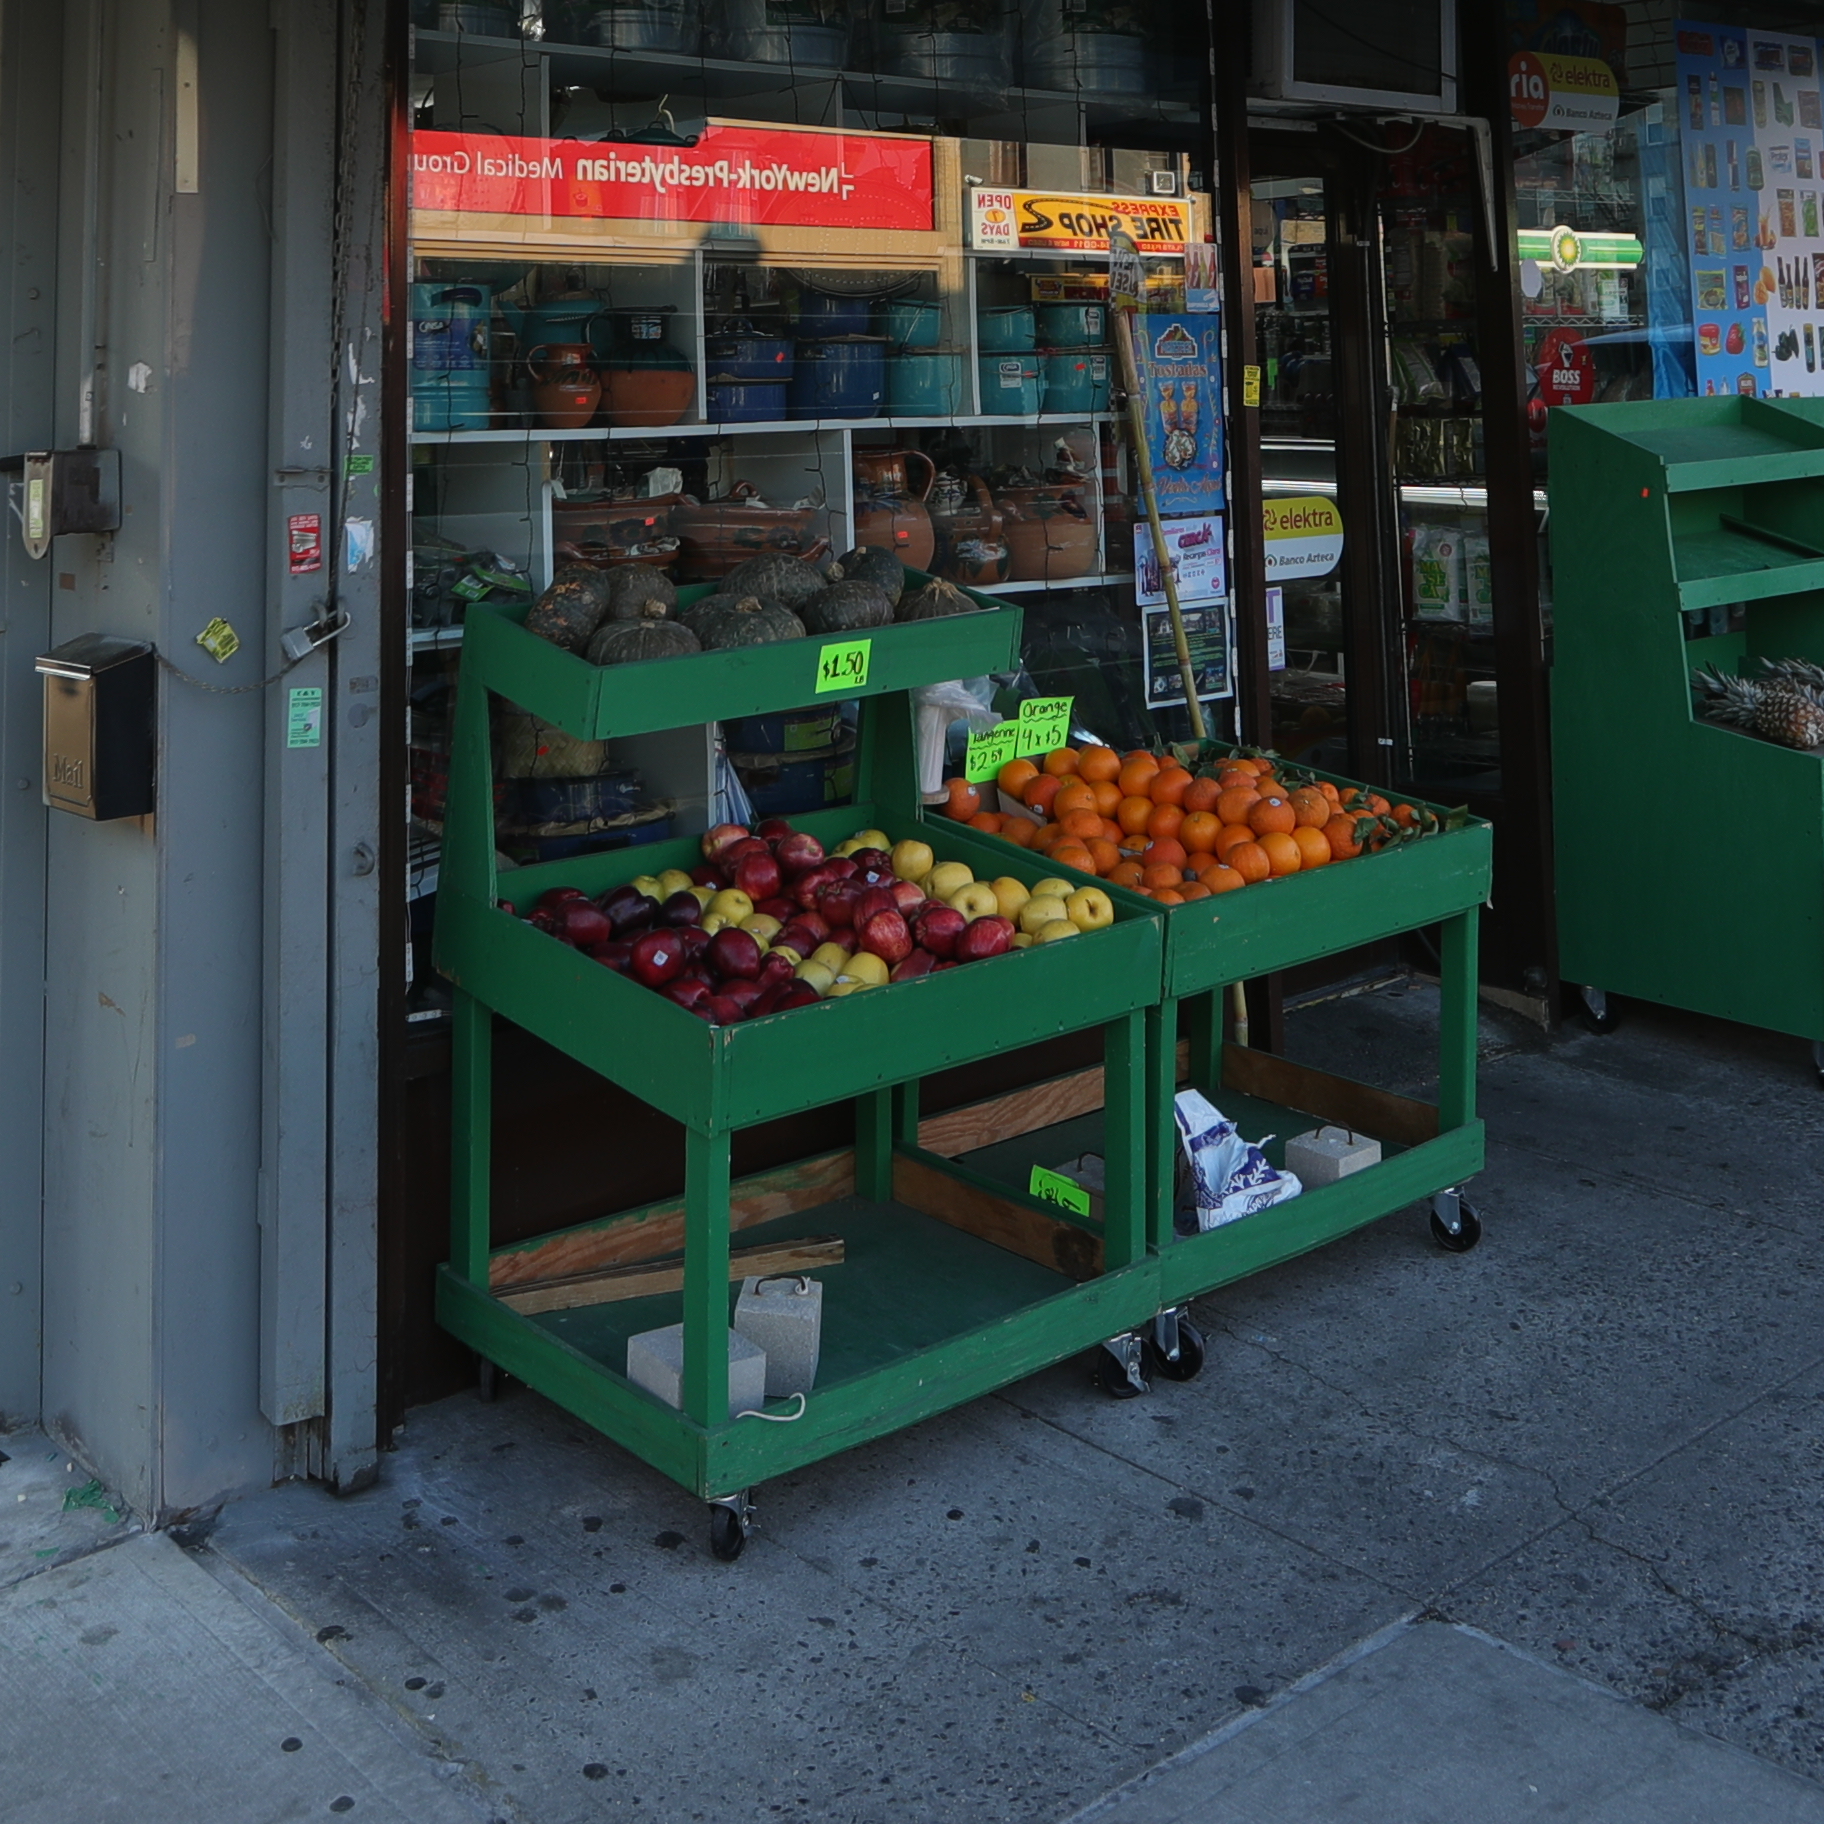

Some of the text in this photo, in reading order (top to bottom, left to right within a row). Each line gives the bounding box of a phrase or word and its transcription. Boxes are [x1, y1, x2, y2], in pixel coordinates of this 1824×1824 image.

[1510, 60, 1610, 99] ria elektra
[1147, 361, 1208, 379] Tostadas
[1552, 369, 1582, 384] BOSS
[1280, 506, 1334, 531] elektra
[1279, 551, 1335, 567] Banco Azteca
[822, 651, 864, 681] $1.50
[1023, 701, 1068, 719] Orange
[53, 752, 83, 789] Mail
